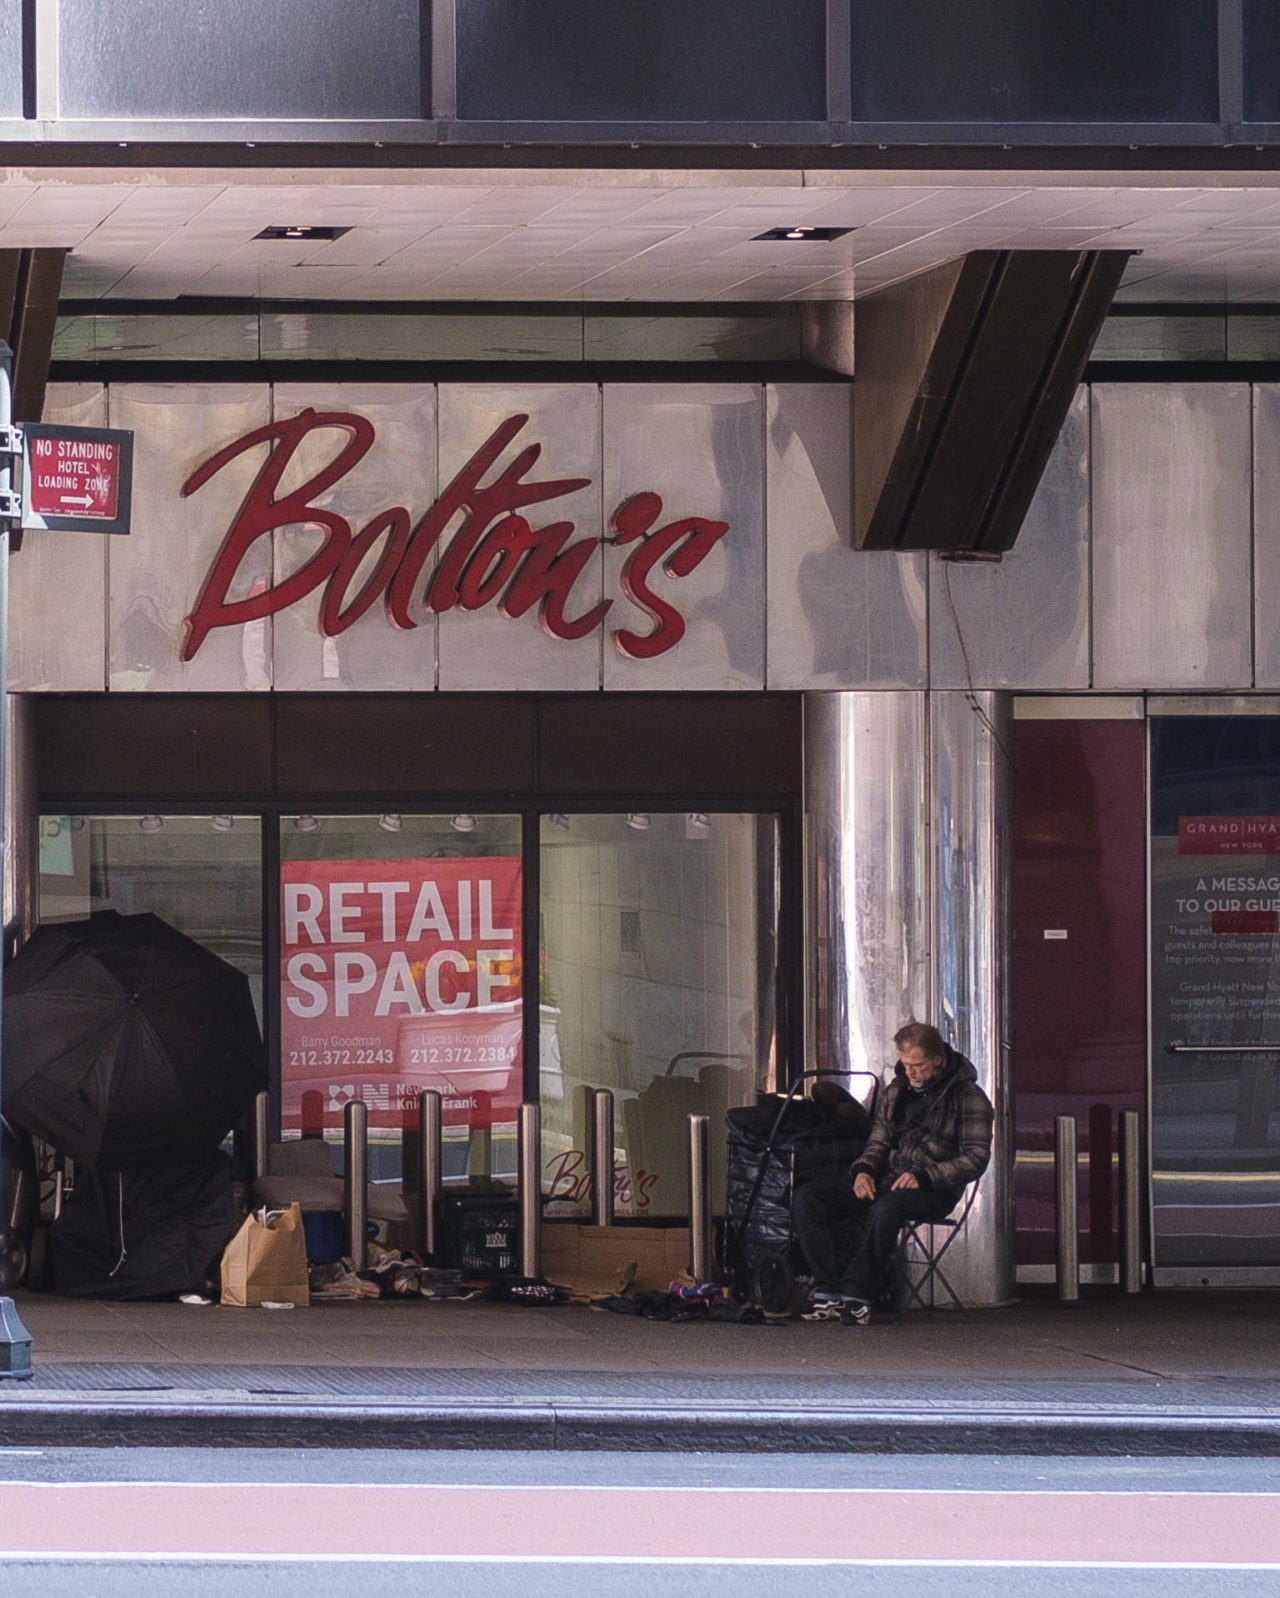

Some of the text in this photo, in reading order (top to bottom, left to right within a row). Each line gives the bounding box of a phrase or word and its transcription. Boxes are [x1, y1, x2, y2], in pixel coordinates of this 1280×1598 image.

[36, 440, 112, 460] NO STANDING
[58, 460, 90, 474] HOTEL
[38, 475, 109, 492] LOADING ZONE
[179, 407, 730, 662] Bolton's
[1186, 823, 1280, 833] GRAND HYA
[1196, 877, 1207, 891] A
[284, 879, 514, 944] RETAIL
[1176, 898, 1200, 912] TO
[1204, 898, 1241, 912] OUR
[1168, 925, 1187, 935] The
[1164, 941, 1195, 952] guests
[1198, 939, 1216, 949] and
[1219, 939, 1269, 951] colleagues
[1165, 953, 1182, 965] top
[286, 949, 515, 1018] SPACE
[1179, 982, 1210, 992] Grand
[1213, 982, 1240, 993] Hyatt
[1242, 982, 1264, 992] New
[1169, 996, 1226, 1008] temporarily
[1169, 1011, 1222, 1021] operations
[1224, 1009, 1246, 1020] until
[301, 1035, 381, 1050] Barry Goodman
[422, 1032, 504, 1047] Lucas Kooyman
[290, 1050, 394, 1066] 212.372.2243
[411, 1046, 517, 1063] 212.372.2384
[441, 1096, 478, 1109] Frank
